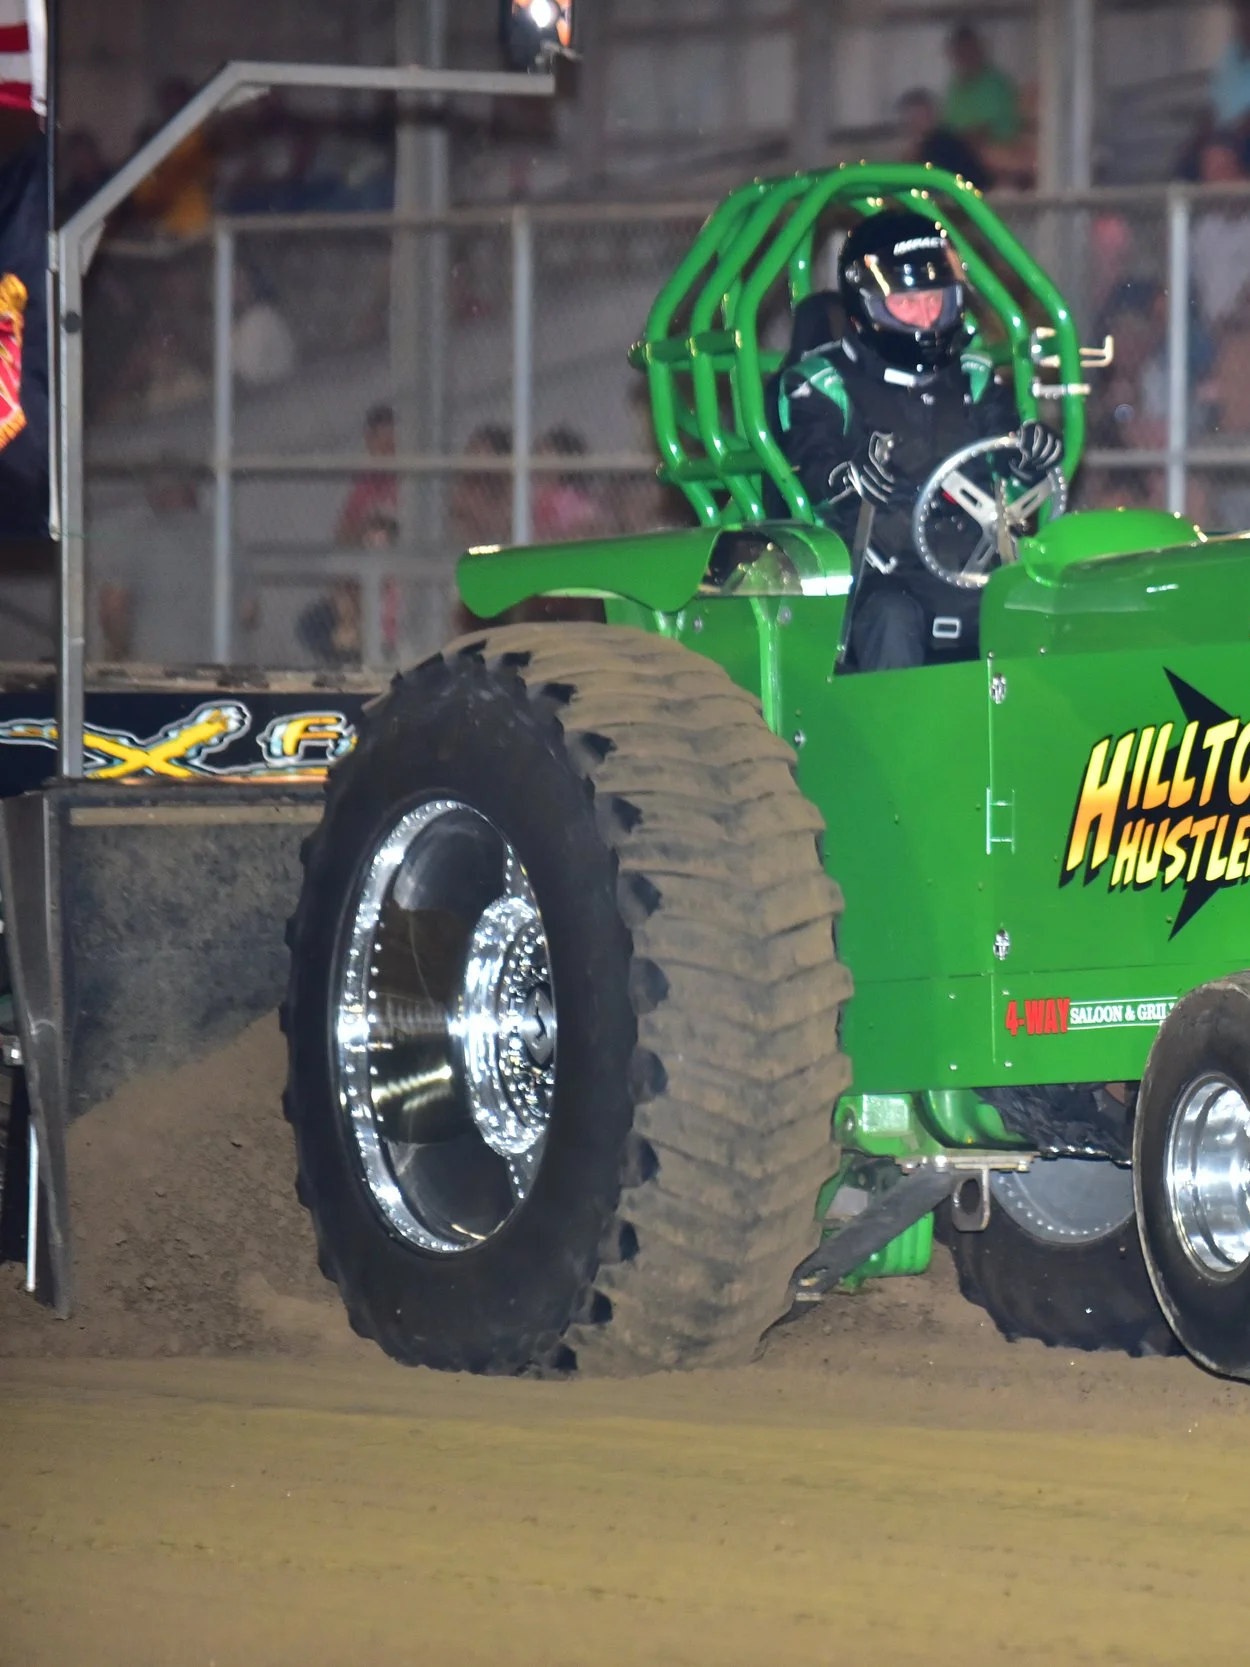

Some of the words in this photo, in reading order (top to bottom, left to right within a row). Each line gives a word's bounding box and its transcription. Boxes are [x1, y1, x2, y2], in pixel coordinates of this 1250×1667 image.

[1005, 997, 1070, 1036] 4-WAY
[1070, 1005, 1122, 1025] SALOON
[1125, 1005, 1136, 1021] &
